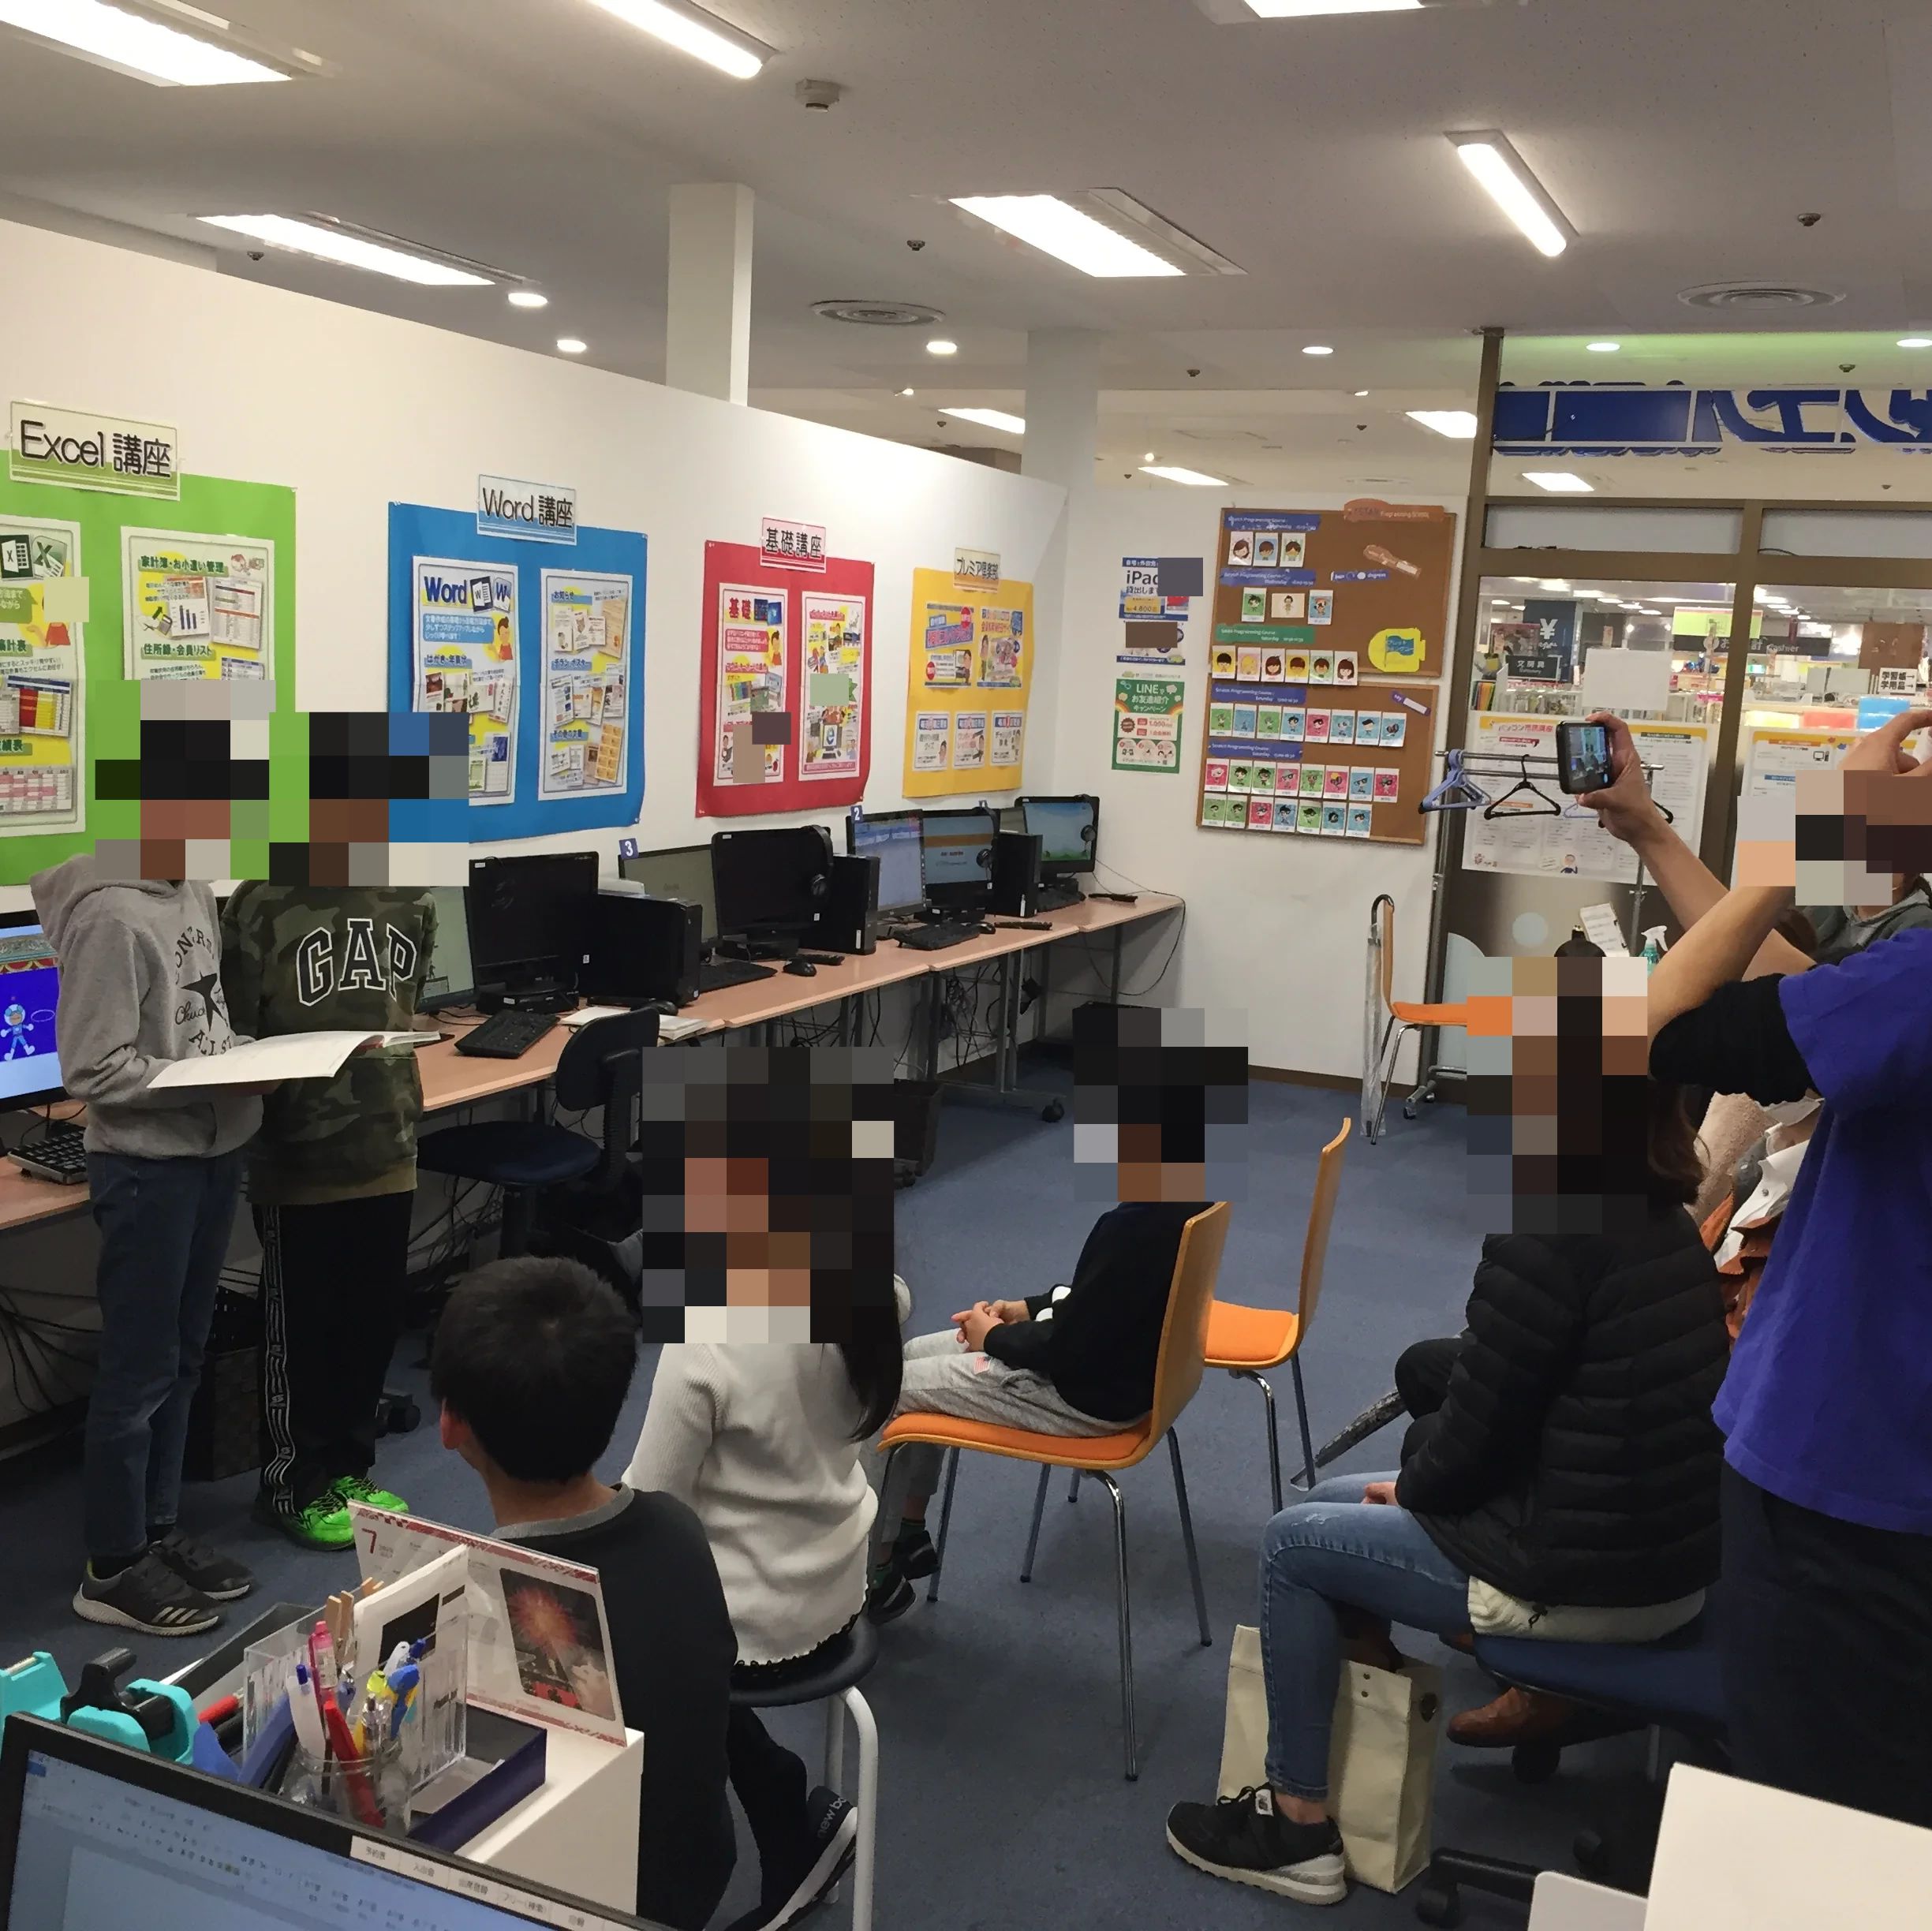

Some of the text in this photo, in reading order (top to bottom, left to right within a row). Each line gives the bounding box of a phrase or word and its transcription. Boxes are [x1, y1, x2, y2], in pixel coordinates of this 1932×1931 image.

[20, 419, 171, 478] Excel 講座
[482, 487, 574, 529] Word 講座
[765, 527, 822, 558] 基礎講座
[140, 555, 225, 573] 家計簿・お小遣い管理
[424, 576, 467, 604] Word
[728, 597, 752, 620] 基礎
[143, 643, 212, 656] 住所録・会員リスト
[1516, 659, 1545, 669] 文房具
[854, 806, 861, 821] 2
[624, 840, 634, 857] 3
[296, 917, 417, 1007] GAP
[361, 1527, 377, 1554] 7
